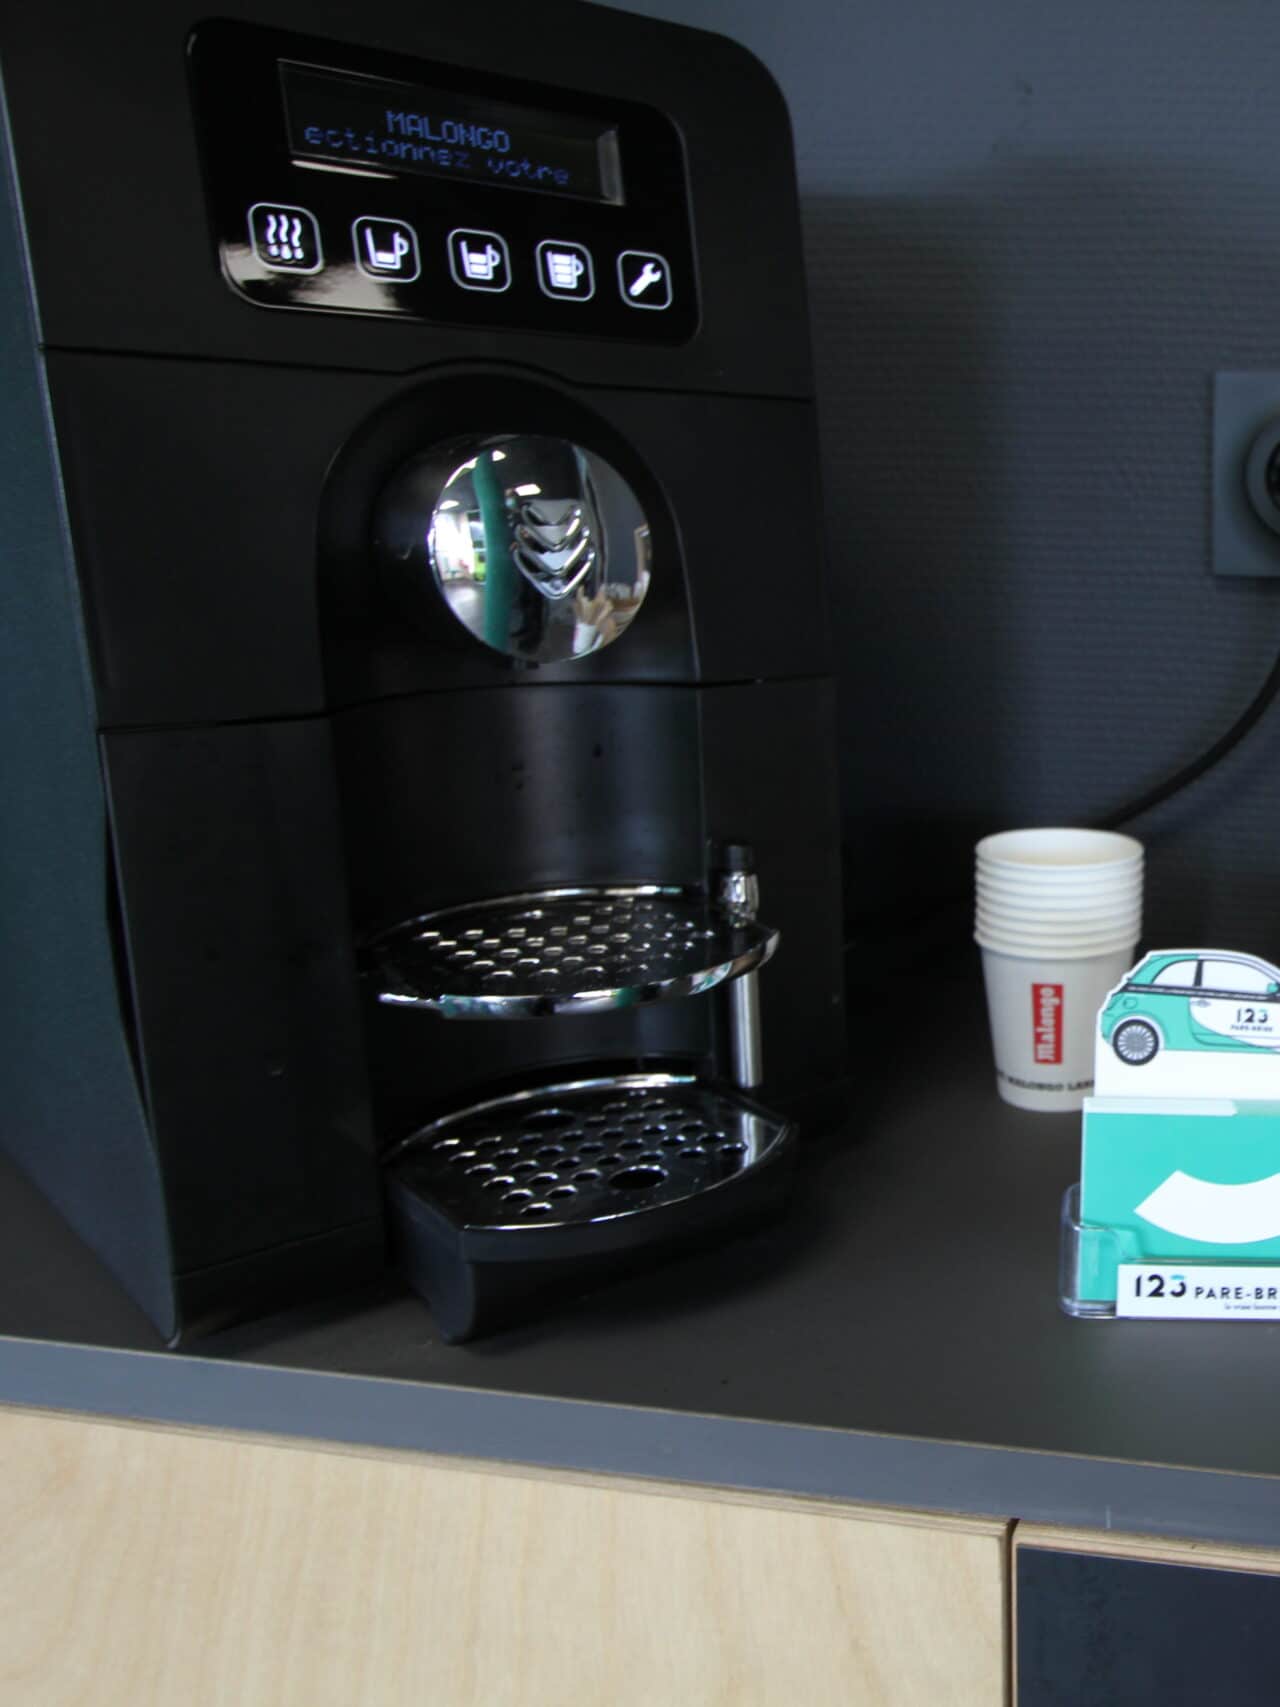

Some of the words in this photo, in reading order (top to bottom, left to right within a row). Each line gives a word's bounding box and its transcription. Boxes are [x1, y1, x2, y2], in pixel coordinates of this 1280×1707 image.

[386, 109, 511, 153] MALONGO
[304, 125, 471, 169] ectionnez
[487, 156, 570, 185] votre
[1035, 986, 1060, 1060] Malongo
[1236, 1007, 1269, 1024] 123
[1135, 1273, 1187, 1298] 123
